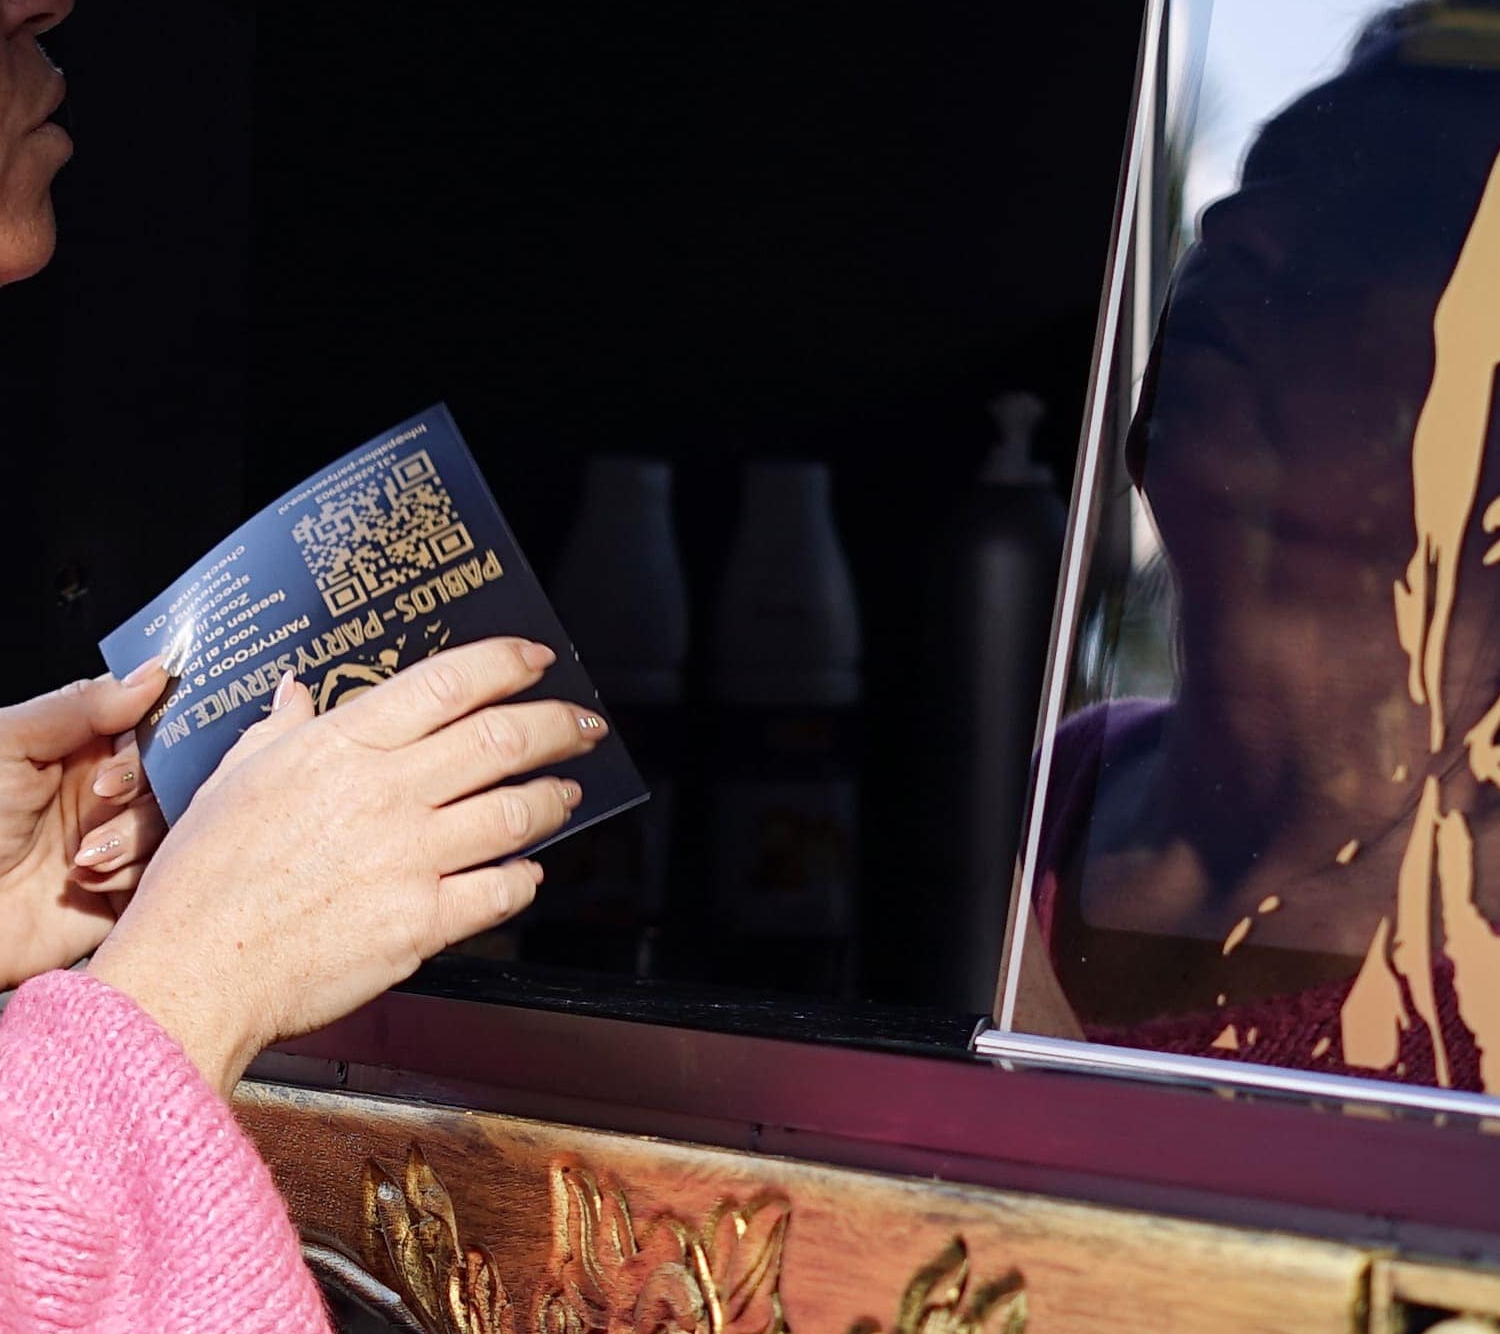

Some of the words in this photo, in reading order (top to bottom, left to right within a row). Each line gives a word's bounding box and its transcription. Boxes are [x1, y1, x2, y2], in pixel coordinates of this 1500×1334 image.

[201, 545, 246, 581] check
[208, 592, 250, 624] Zoek
[226, 589, 287, 630] feesten
[143, 613, 167, 637] QR
[203, 627, 227, 644] en
[220, 624, 260, 651] voor
[154, 549, 503, 748] PABLOS-PARTYSERVICE.NL
[205, 647, 222, 662] al
[208, 615, 311, 678] PARTYFOOD
[179, 656, 204, 679] jou
[192, 672, 206, 687] &
[151, 683, 192, 723] MORE
